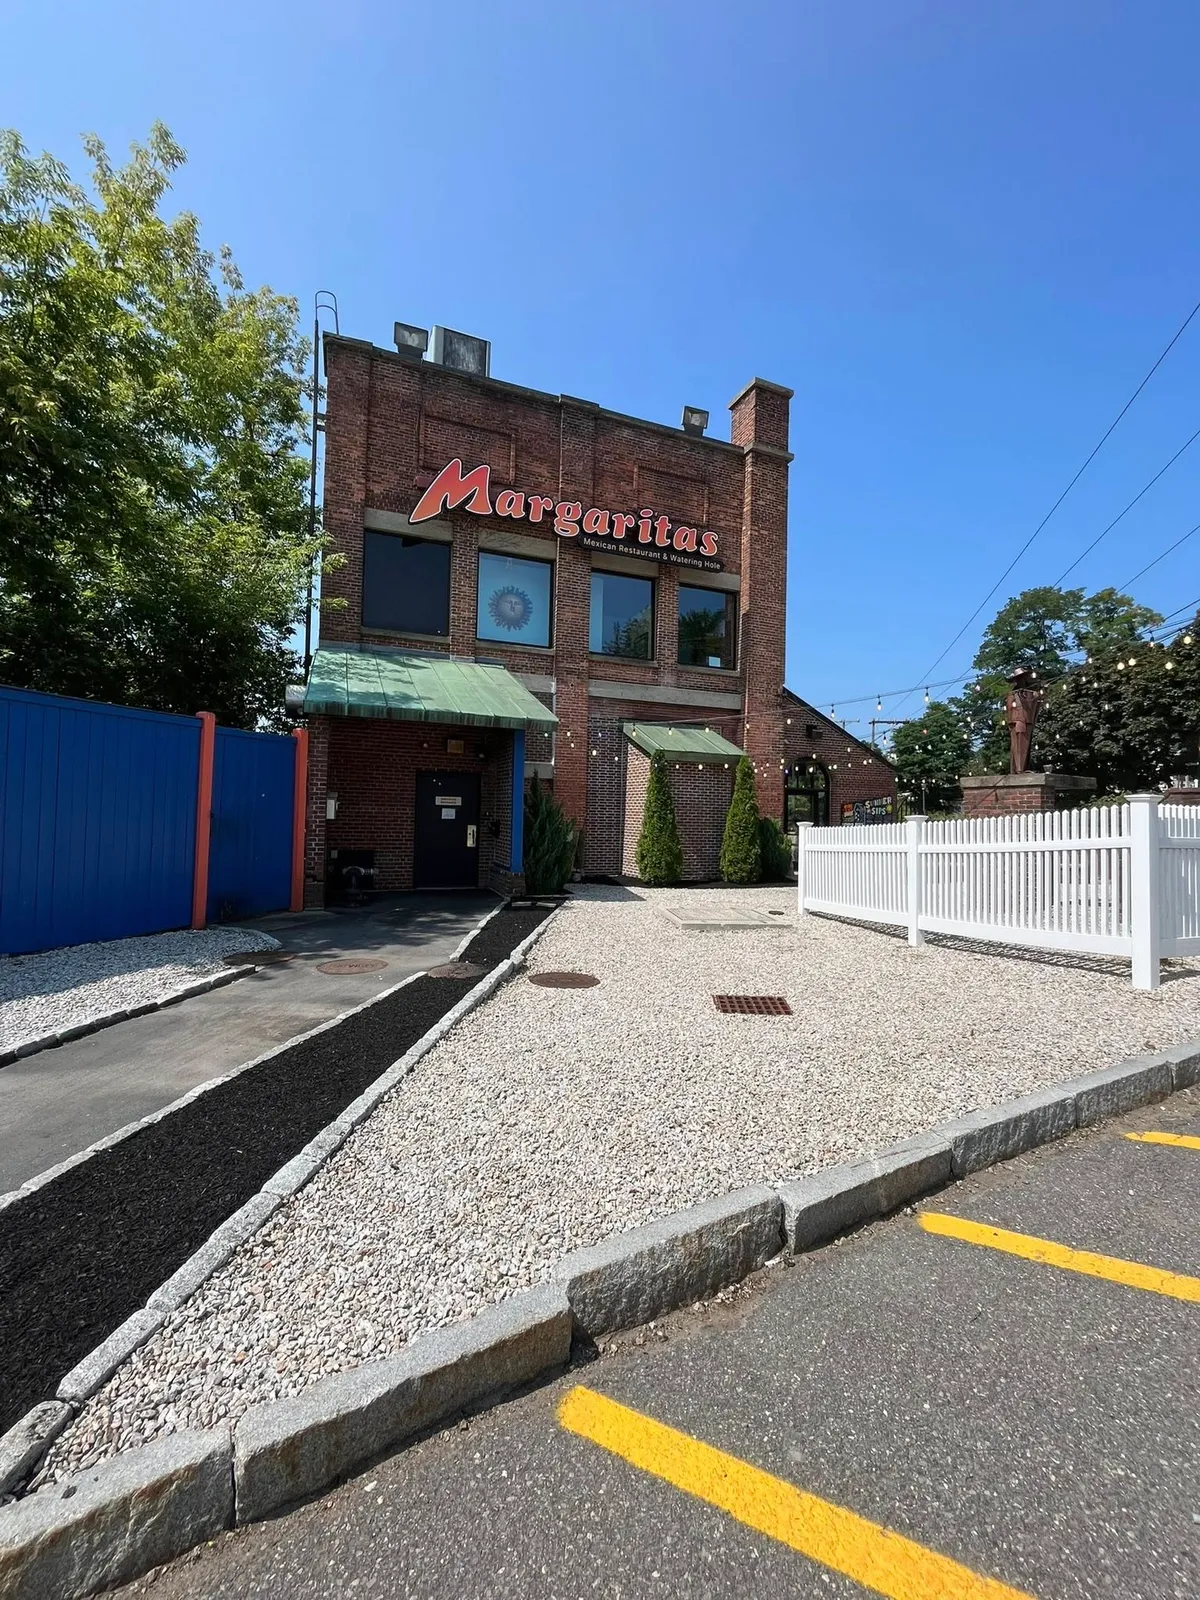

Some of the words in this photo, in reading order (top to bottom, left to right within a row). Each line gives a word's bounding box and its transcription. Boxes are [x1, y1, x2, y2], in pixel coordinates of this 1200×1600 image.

[410, 458, 719, 556] Margaritas
[583, 537, 616, 550] Mexican
[618, 544, 661, 559] Restaurant
[670, 554, 702, 568] Watering
[704, 561, 721, 570] Hole
[865, 796, 892, 809] SER
